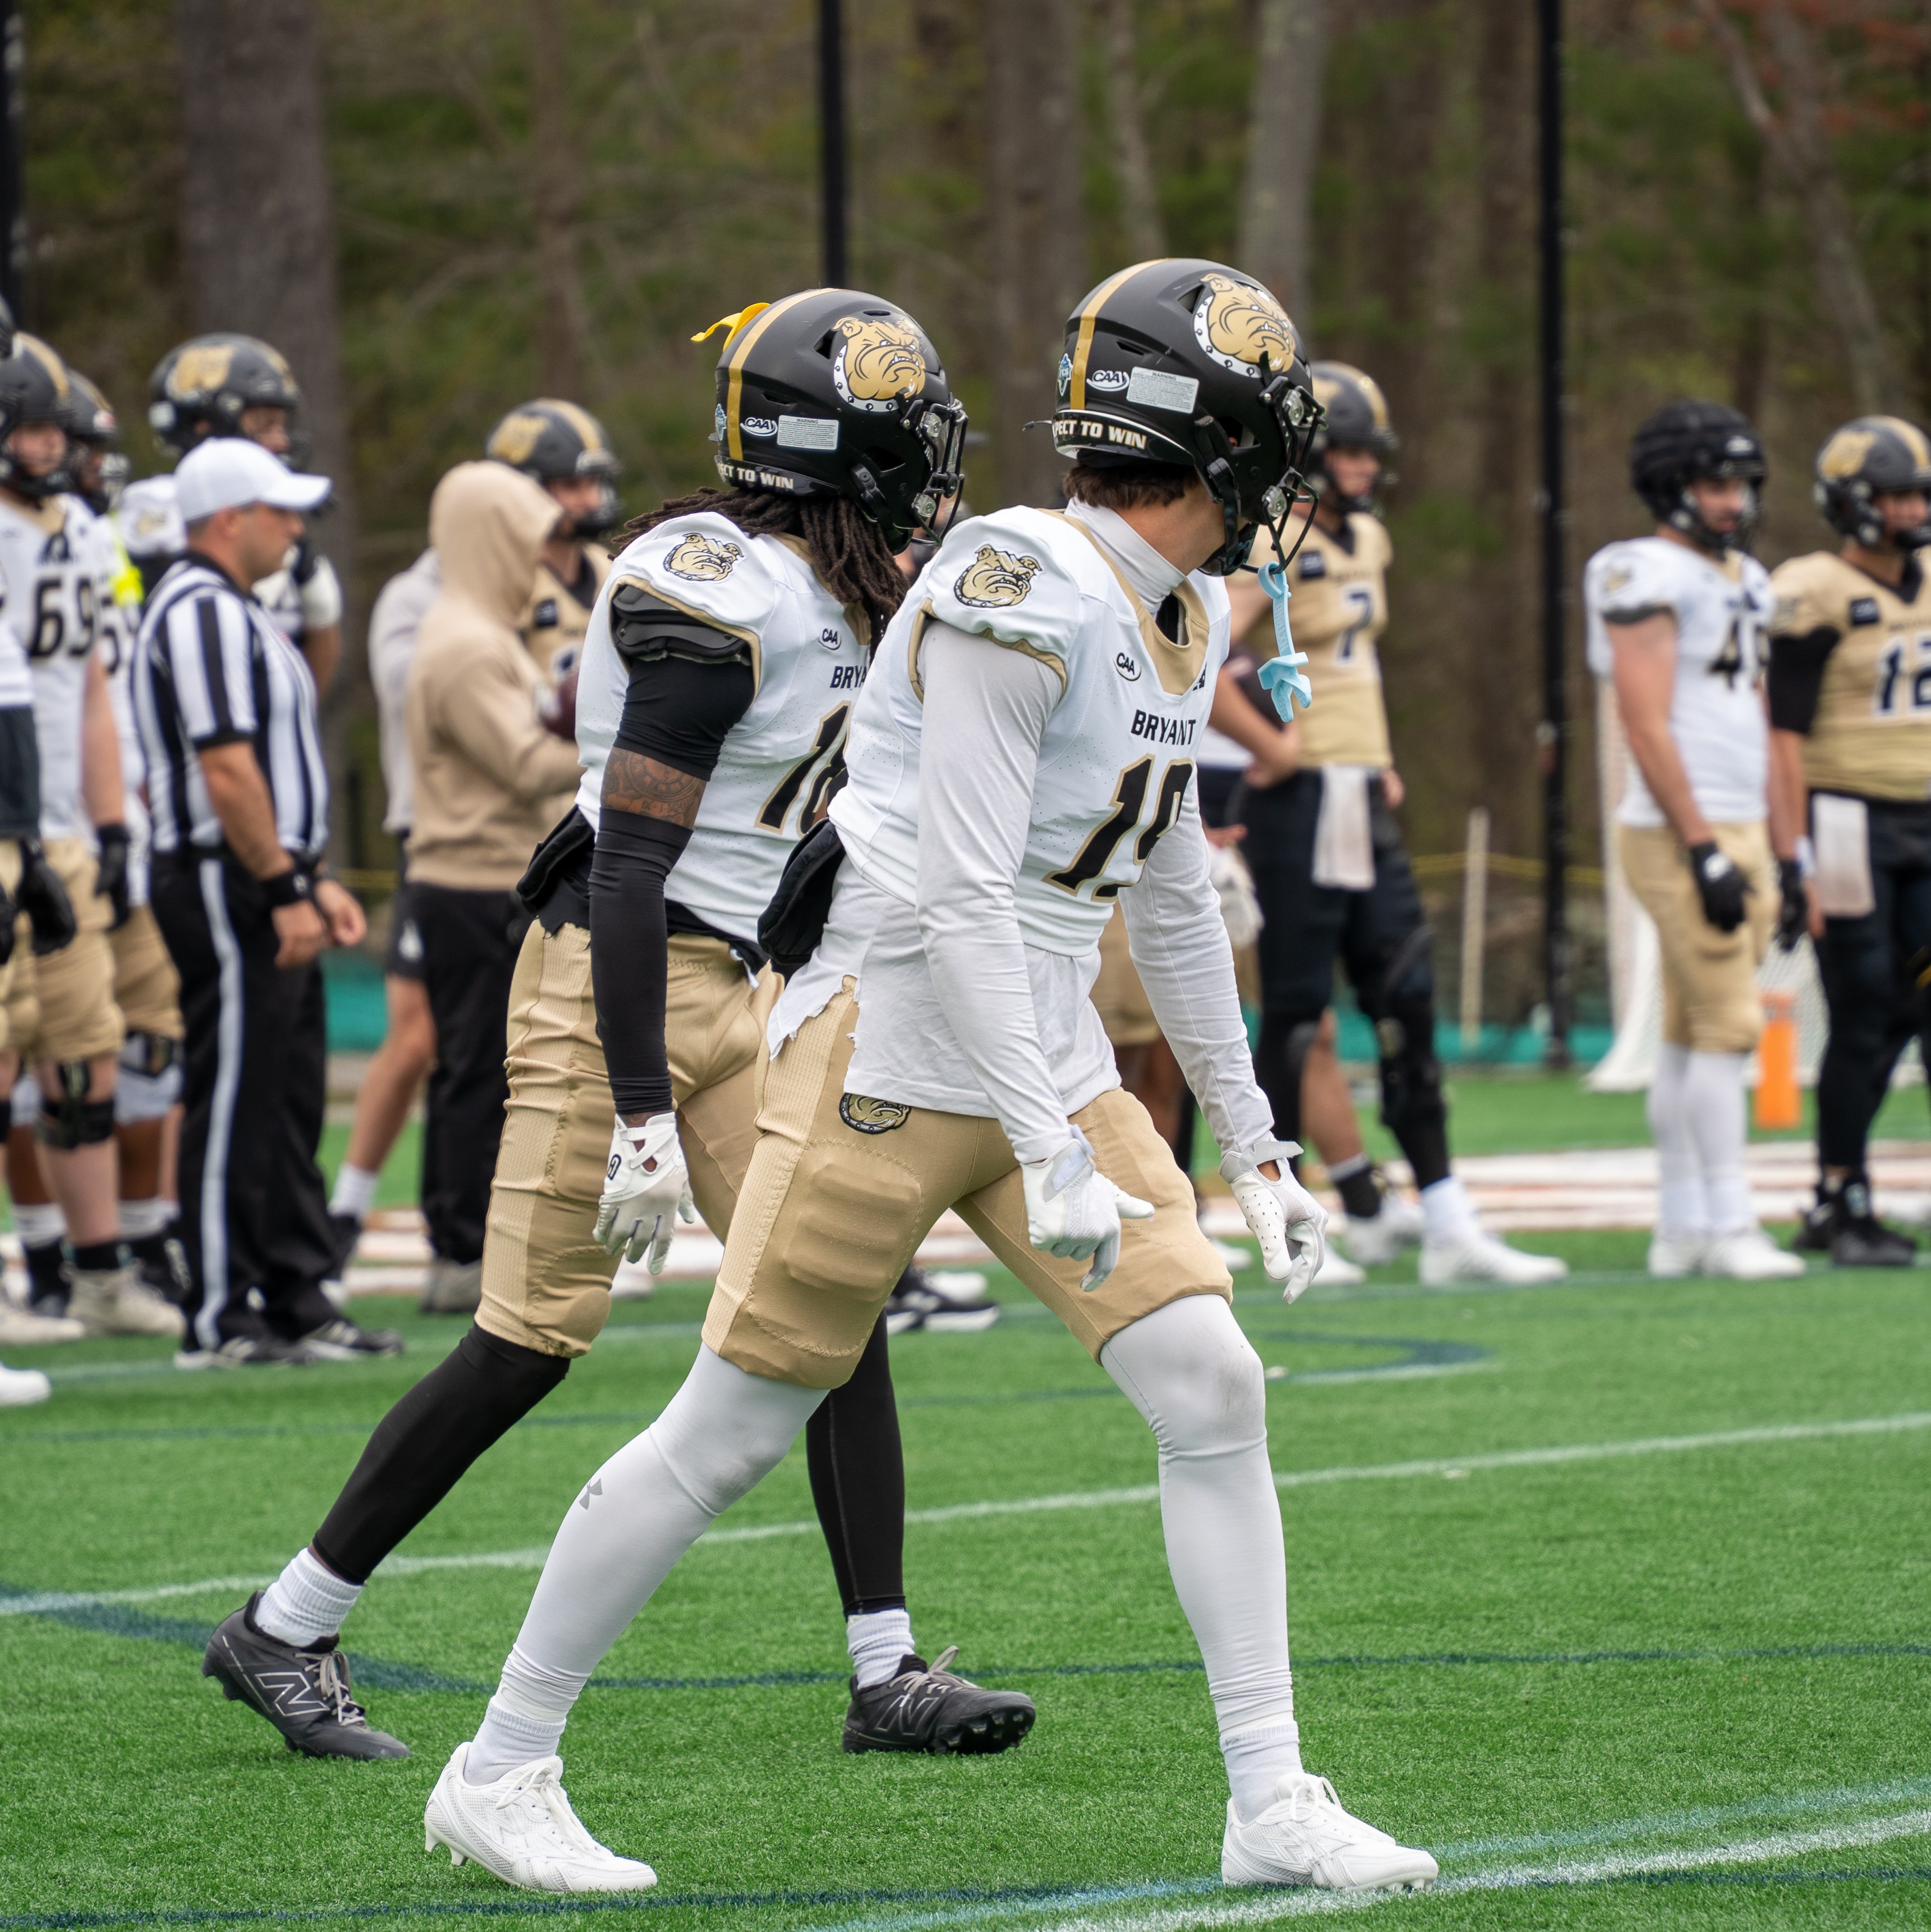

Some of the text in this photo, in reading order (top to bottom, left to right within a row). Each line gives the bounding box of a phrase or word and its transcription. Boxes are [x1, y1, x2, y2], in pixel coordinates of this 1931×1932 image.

[1092, 369, 1121, 383] CAA
[1152, 372, 1176, 381] WARNING
[746, 418, 771, 430] CAA
[1080, 420, 1103, 439] TO
[1108, 425, 1148, 450] WIN
[737, 467, 756, 482] TO
[759, 471, 794, 490] WIN
[28, 574, 95, 660] 69
[1340, 586, 1375, 662] 7
[822, 628, 838, 645] CAA
[1116, 652, 1135, 676] CAA
[1130, 709, 1196, 746] BRYANT
